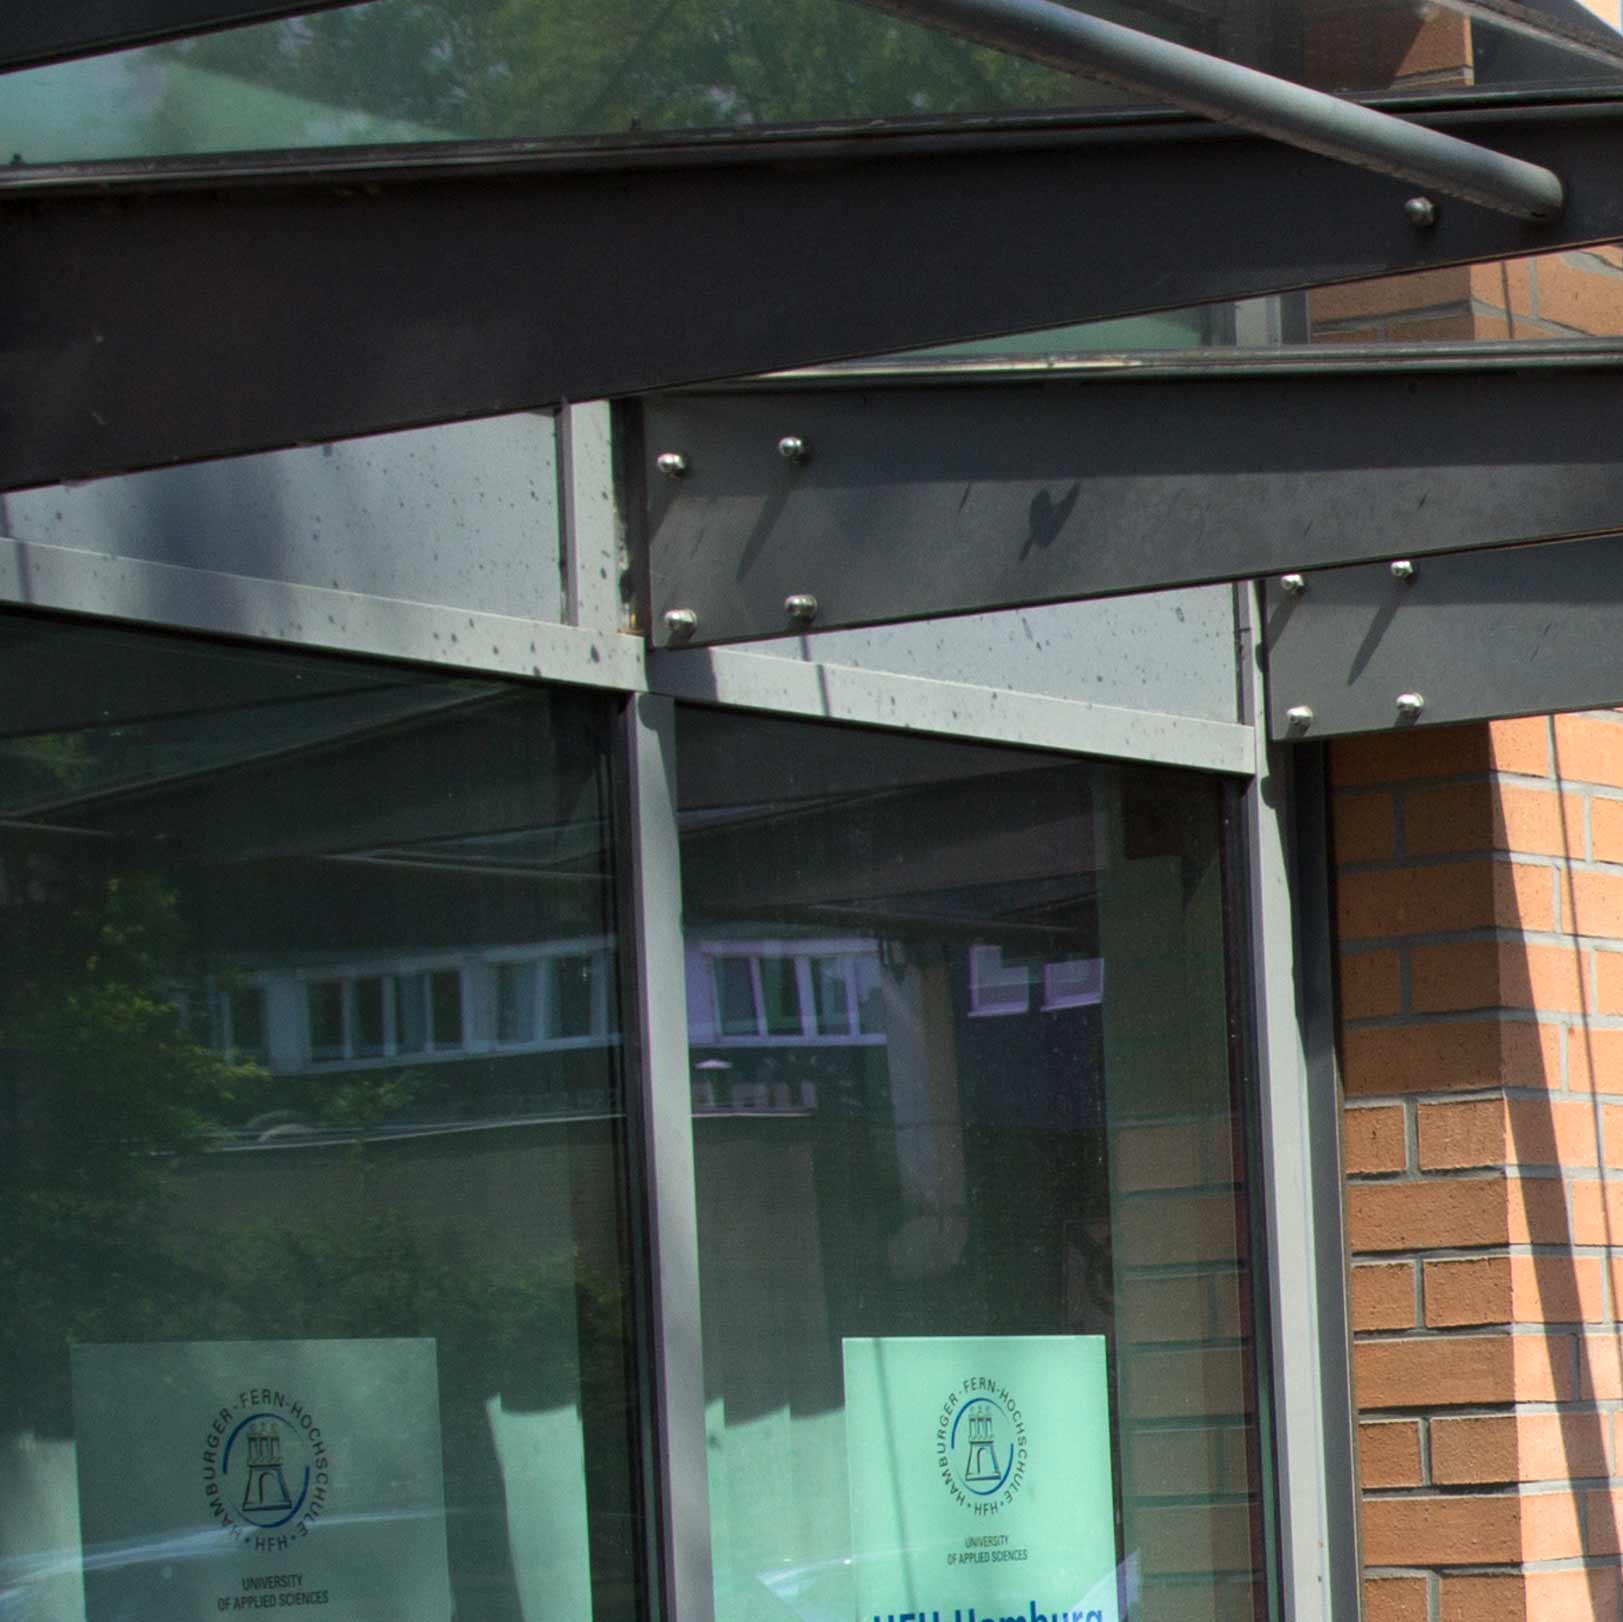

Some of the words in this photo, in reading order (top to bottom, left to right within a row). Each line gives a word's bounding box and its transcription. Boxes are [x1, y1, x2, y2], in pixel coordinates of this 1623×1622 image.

[937, 1393, 965, 1507] HAMBURGER
[963, 1377, 1028, 1503] FERN-HOCHSCHULE
[203, 1408, 242, 1541] HAMBURGER
[240, 1388, 329, 1537] FERN-HOCHSCHULE
[974, 1503, 998, 1516] HFH
[255, 1535, 288, 1551] HFH
[965, 1535, 1009, 1549] UNIVERSITY
[947, 1553, 957, 1565] OF
[958, 1551, 990, 1564] APPLIED
[991, 1549, 1028, 1562] SCIENCES
[242, 1574, 303, 1591] UNIVERSITY
[217, 1598, 232, 1612] OF
[233, 1594, 277, 1609] APPLIED
[279, 1591, 329, 1606] SCIENCES
